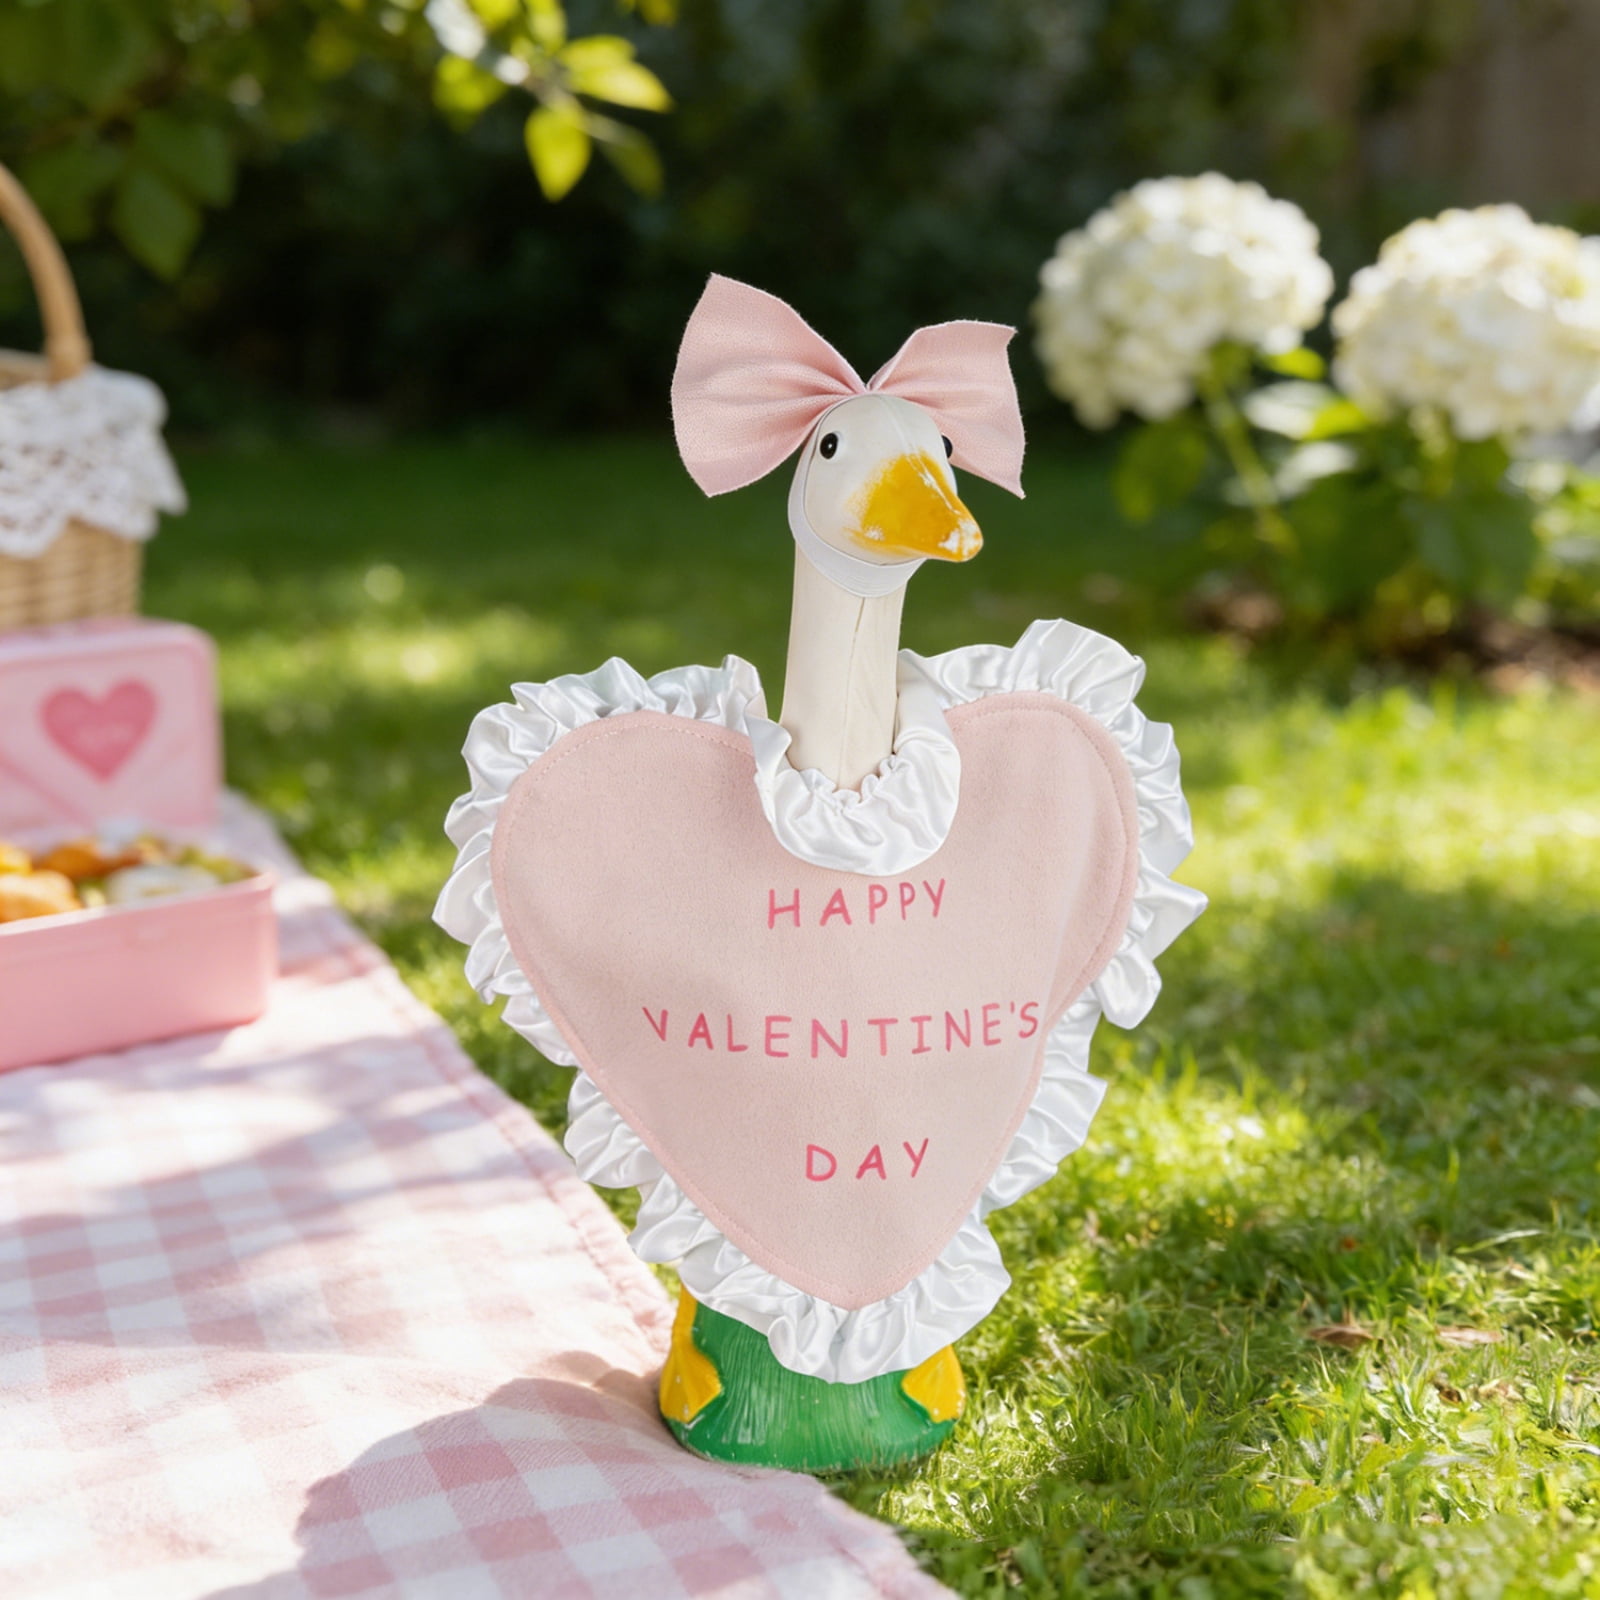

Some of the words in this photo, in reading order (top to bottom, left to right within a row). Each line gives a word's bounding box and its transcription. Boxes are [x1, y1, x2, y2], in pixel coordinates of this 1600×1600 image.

[767, 878, 946, 929] HAPPY
[642, 1001, 1039, 1058] VALENTINE'S
[805, 1138, 929, 1182] DAY
